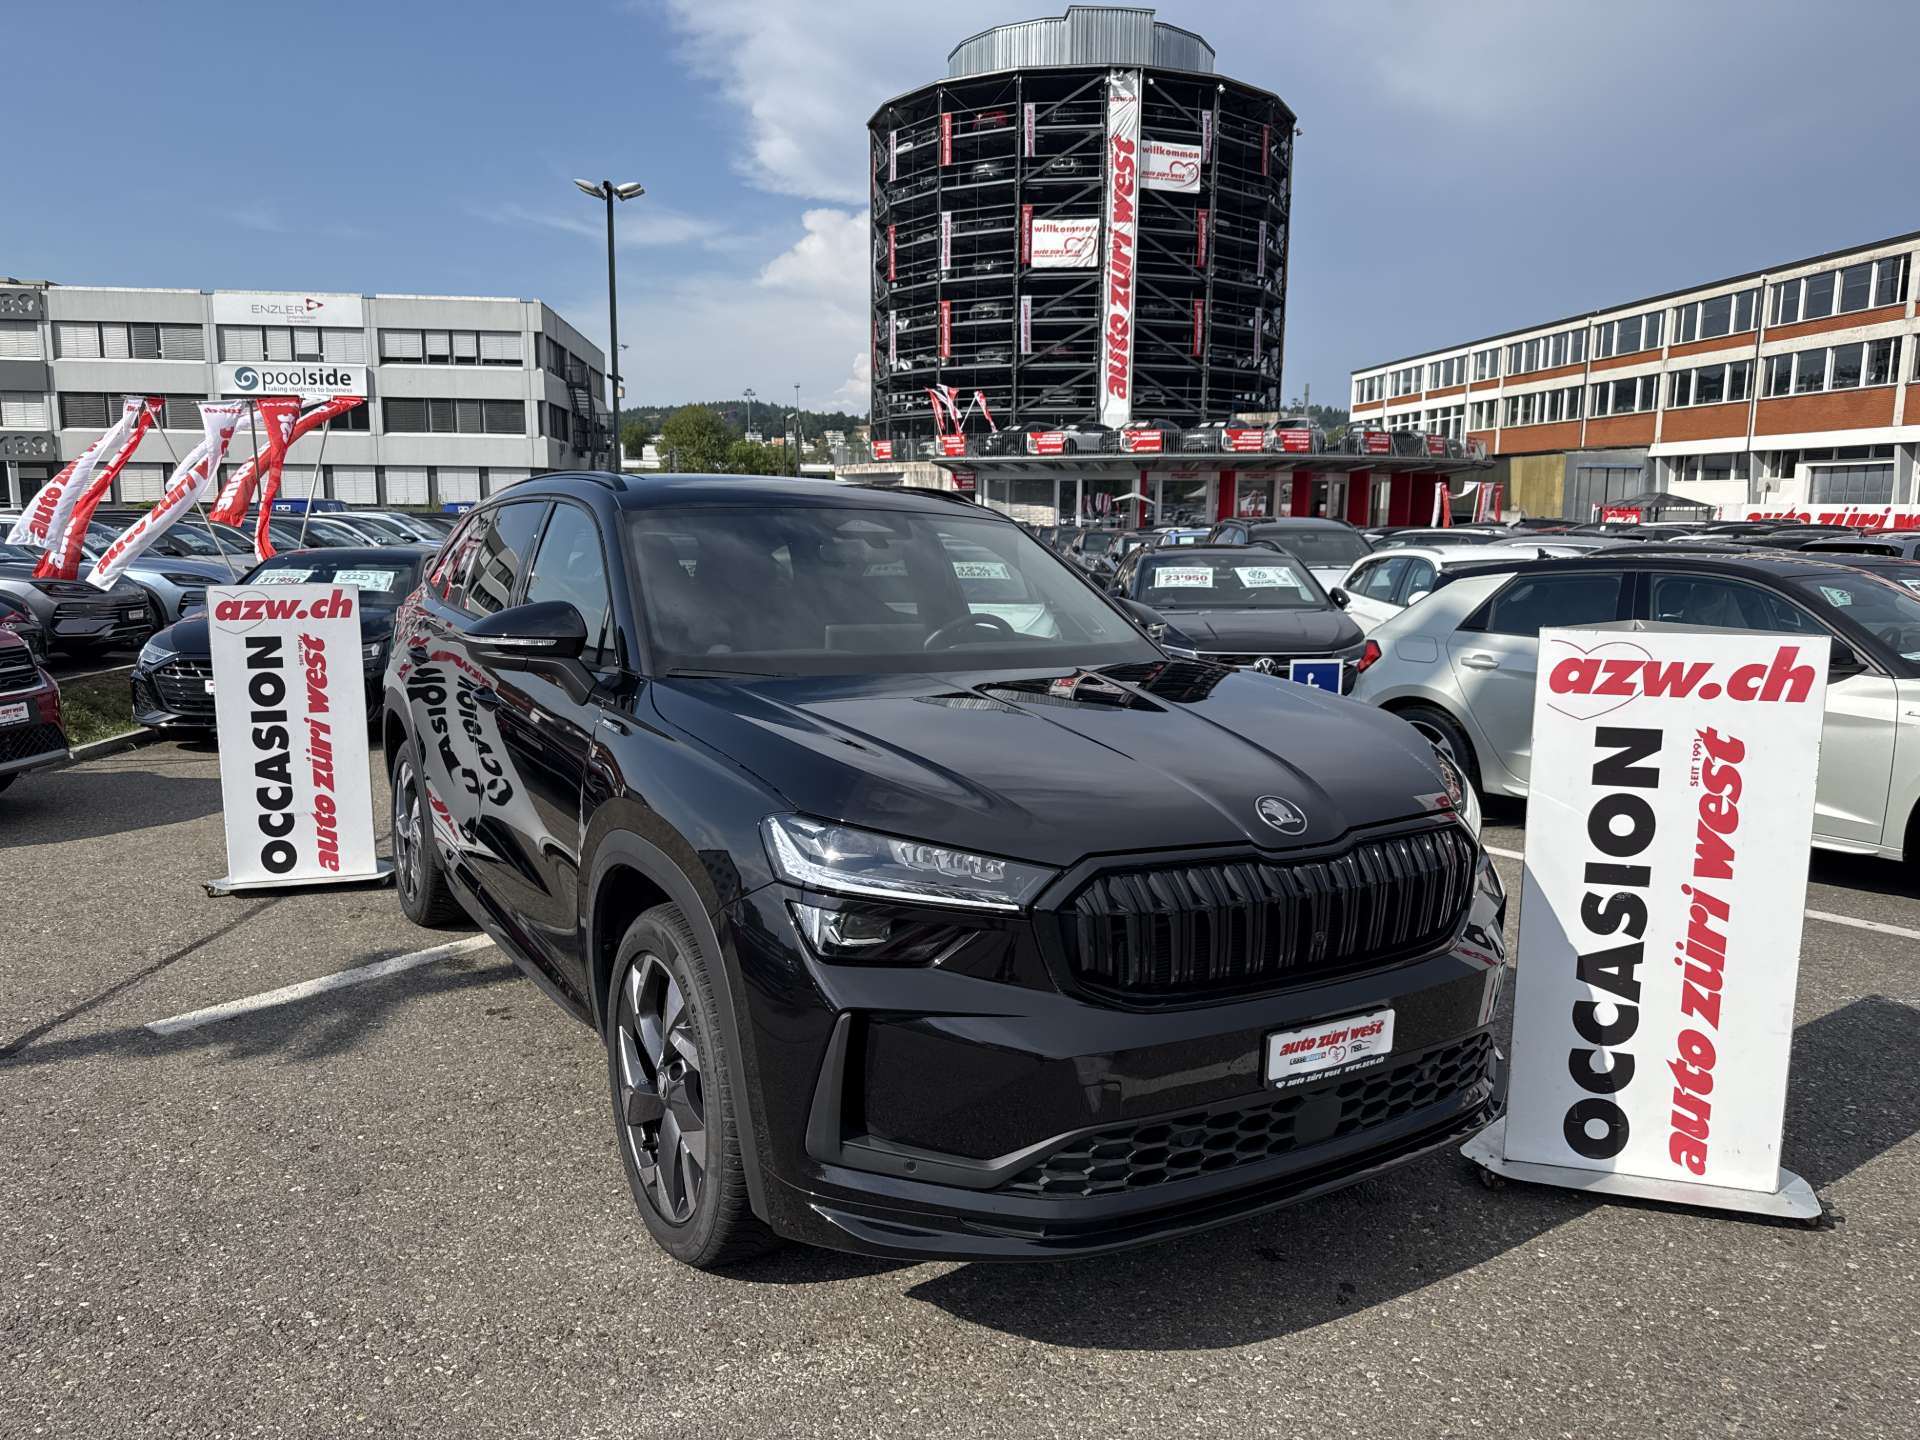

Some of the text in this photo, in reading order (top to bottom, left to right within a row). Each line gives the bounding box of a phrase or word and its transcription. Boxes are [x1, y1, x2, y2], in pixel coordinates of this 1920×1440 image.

[1113, 133, 1135, 225] west
[251, 304, 304, 315] ENZLER
[262, 367, 352, 392] poolside
[1107, 311, 1130, 400] auto
[29, 486, 62, 540] auto
[215, 589, 353, 621] azw.ch
[1548, 645, 1817, 704] azw.ch
[244, 635, 298, 874] OCCASION
[299, 632, 340, 873] auto züri west
[1689, 738, 1703, 787] SEIT 1991
[1562, 725, 1664, 1160] OCCASION
[1666, 725, 1746, 1176] auto züri west
[1280, 1036, 1317, 1057] auto
[1317, 1027, 1350, 1049] züri
[1350, 1020, 1385, 1041] west
